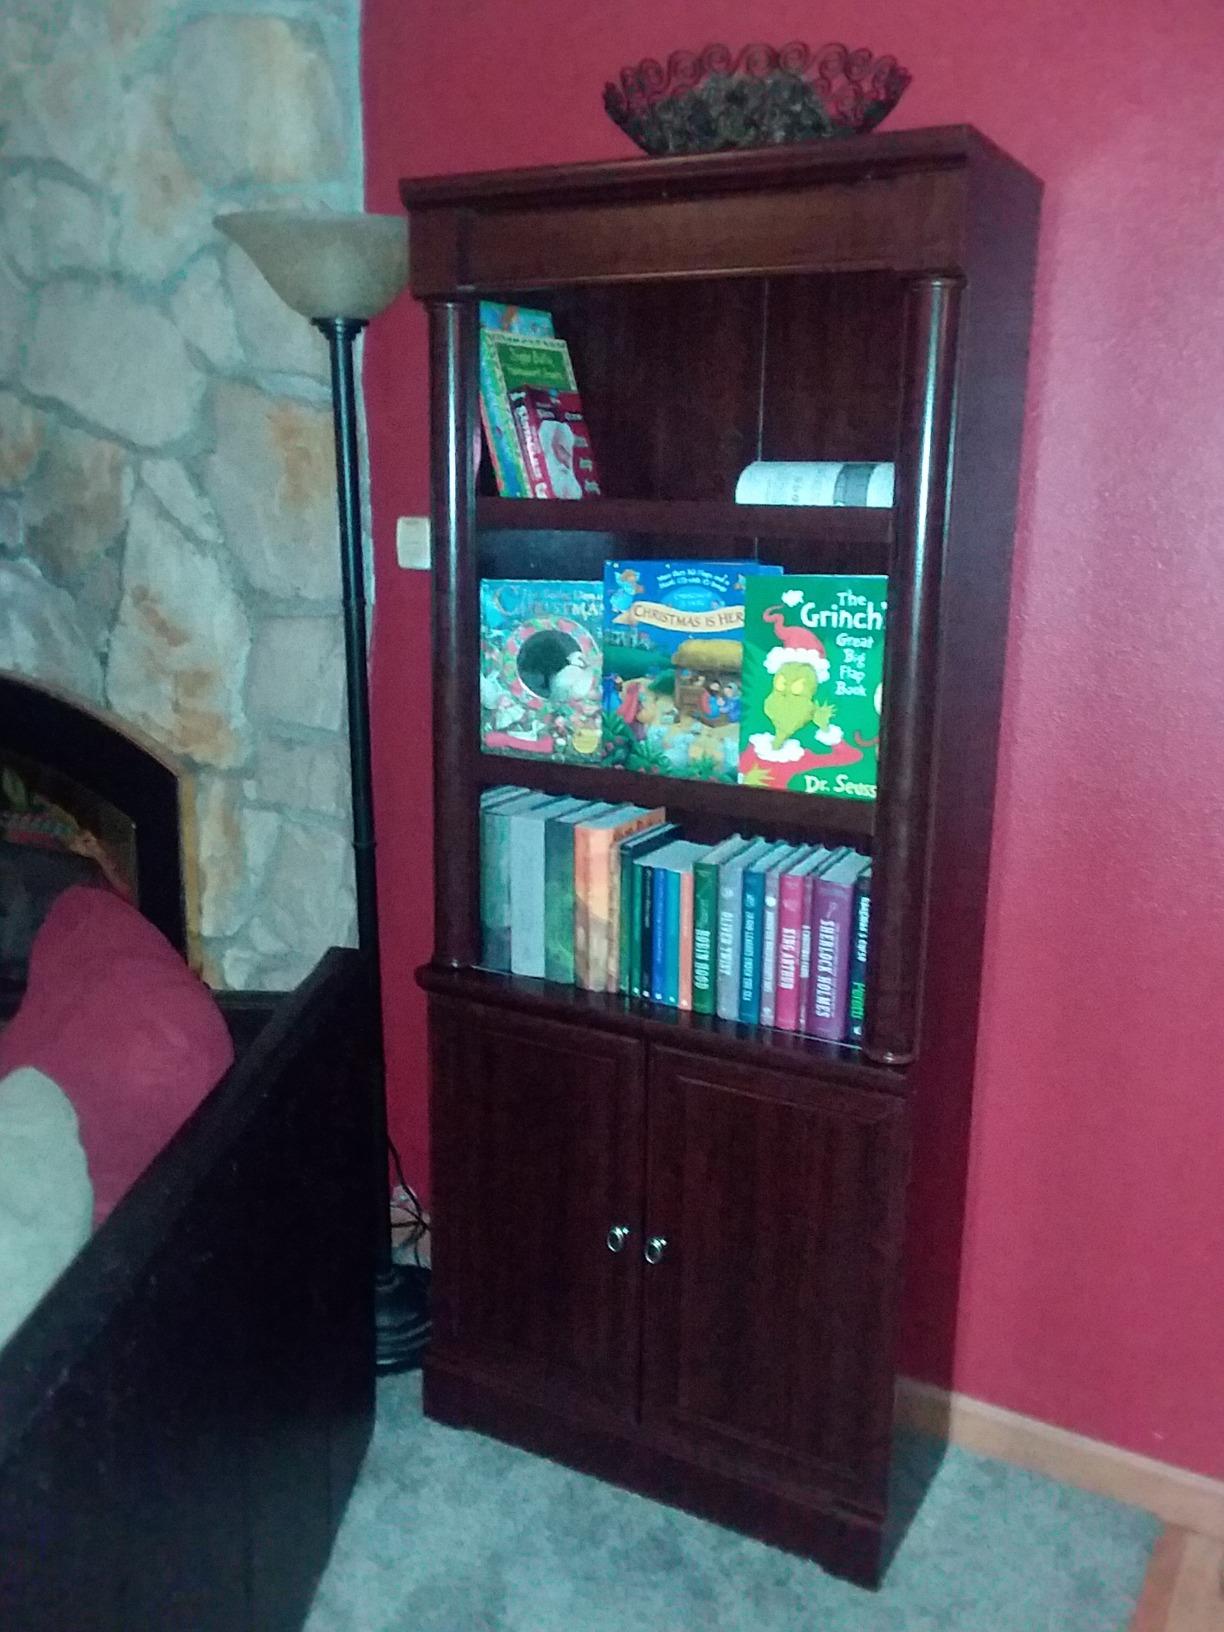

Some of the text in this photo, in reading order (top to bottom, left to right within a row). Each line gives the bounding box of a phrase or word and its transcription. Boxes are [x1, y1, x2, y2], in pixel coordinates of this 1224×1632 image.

[494, 584, 604, 617] CHRISTMA
[836, 589, 867, 607] The
[633, 604, 745, 628] CHRISTMAS IS HER
[800, 601, 888, 631] Grinch'
[836, 632, 874, 649] Great
[843, 648, 866, 669] Big
[839, 665, 866, 684] Flap
[835, 680, 867, 697] Book
[804, 774, 877, 799] Dr. Seuss
[694, 928, 711, 961] ROBIN
[719, 911, 734, 976] OLIVER TWIST
[779, 927, 796, 990] KING ARTHUR
[815, 919, 835, 1018] SHERLOCK HOLMES
[694, 962, 711, 990] HOOD
